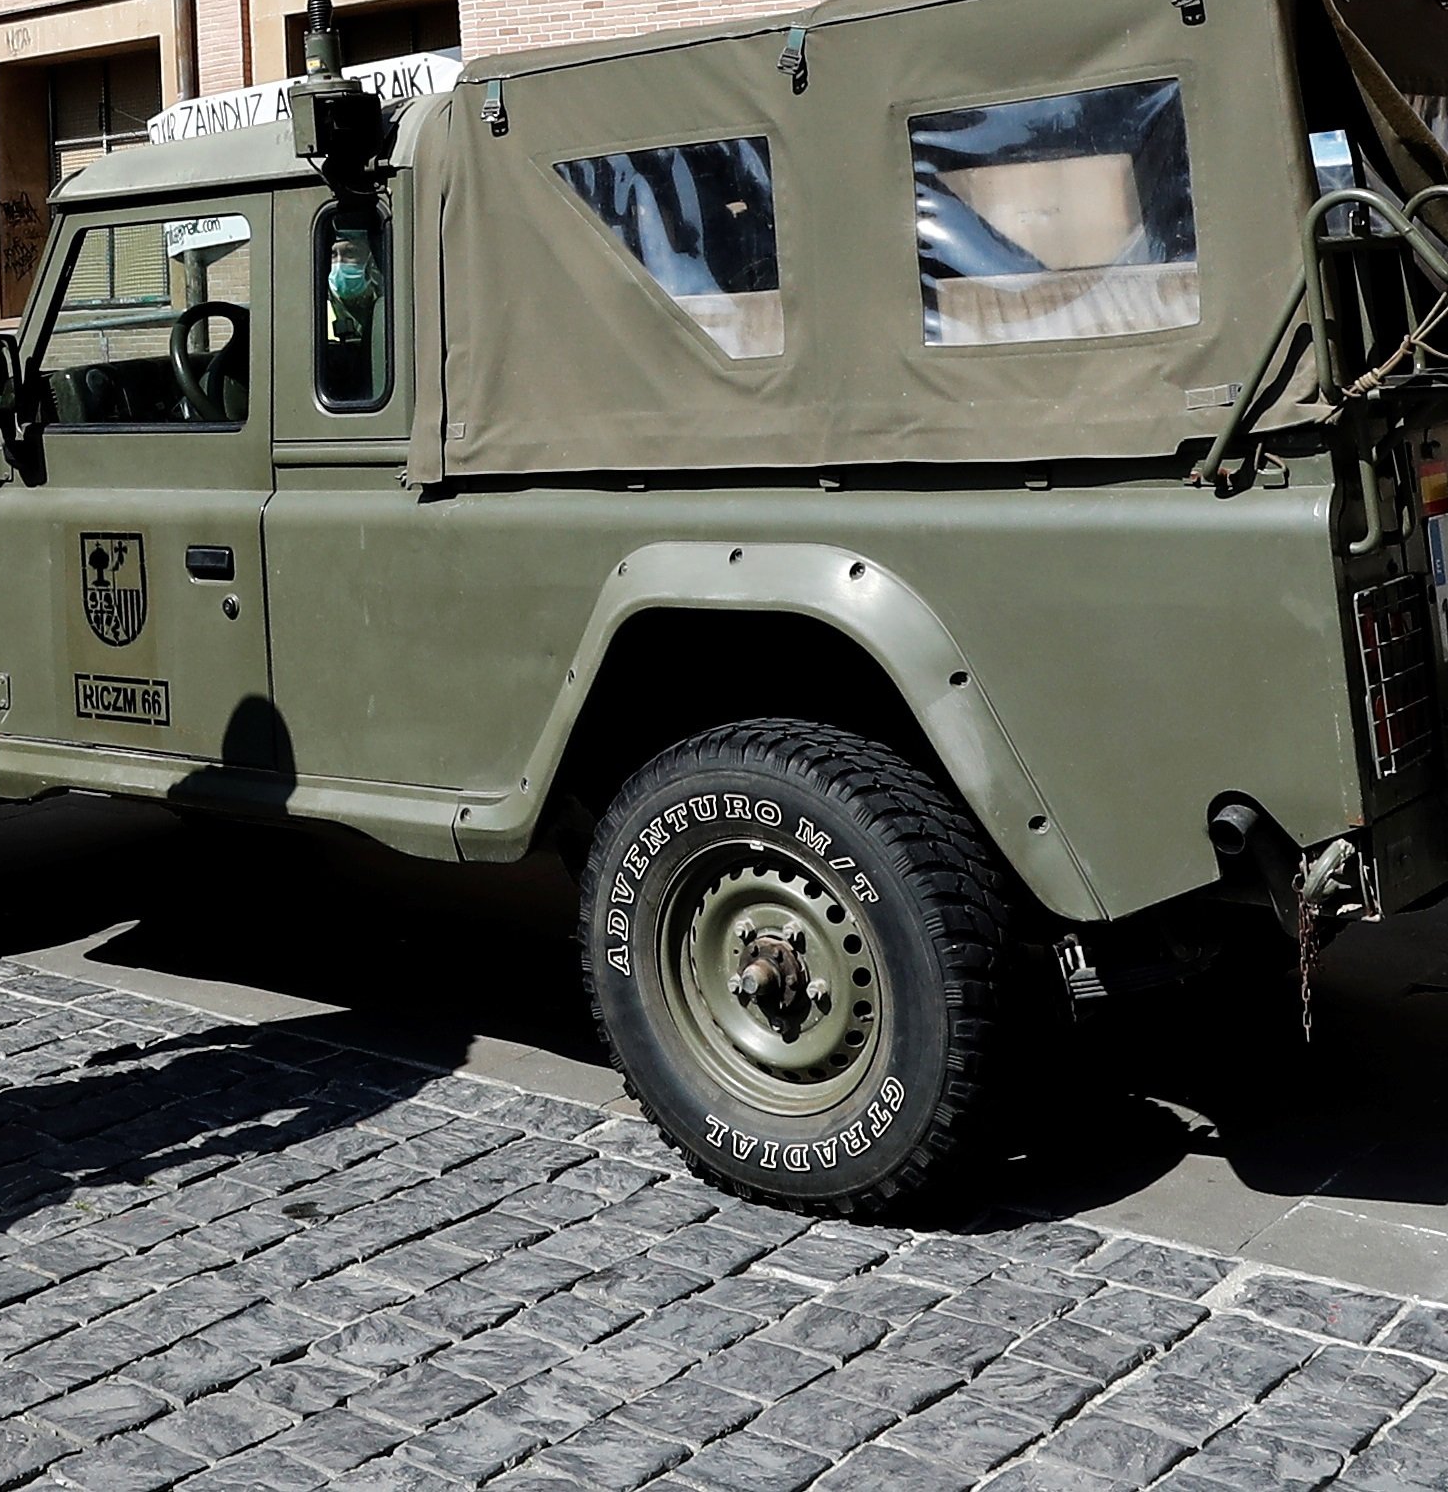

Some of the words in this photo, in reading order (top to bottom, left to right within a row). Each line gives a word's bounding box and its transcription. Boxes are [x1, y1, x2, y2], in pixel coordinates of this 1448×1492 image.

[82, 684, 137, 714] RICZM
[141, 689, 162, 716] 66
[607, 794, 783, 977] ADVENTURO
[796, 817, 880, 904] M/T
